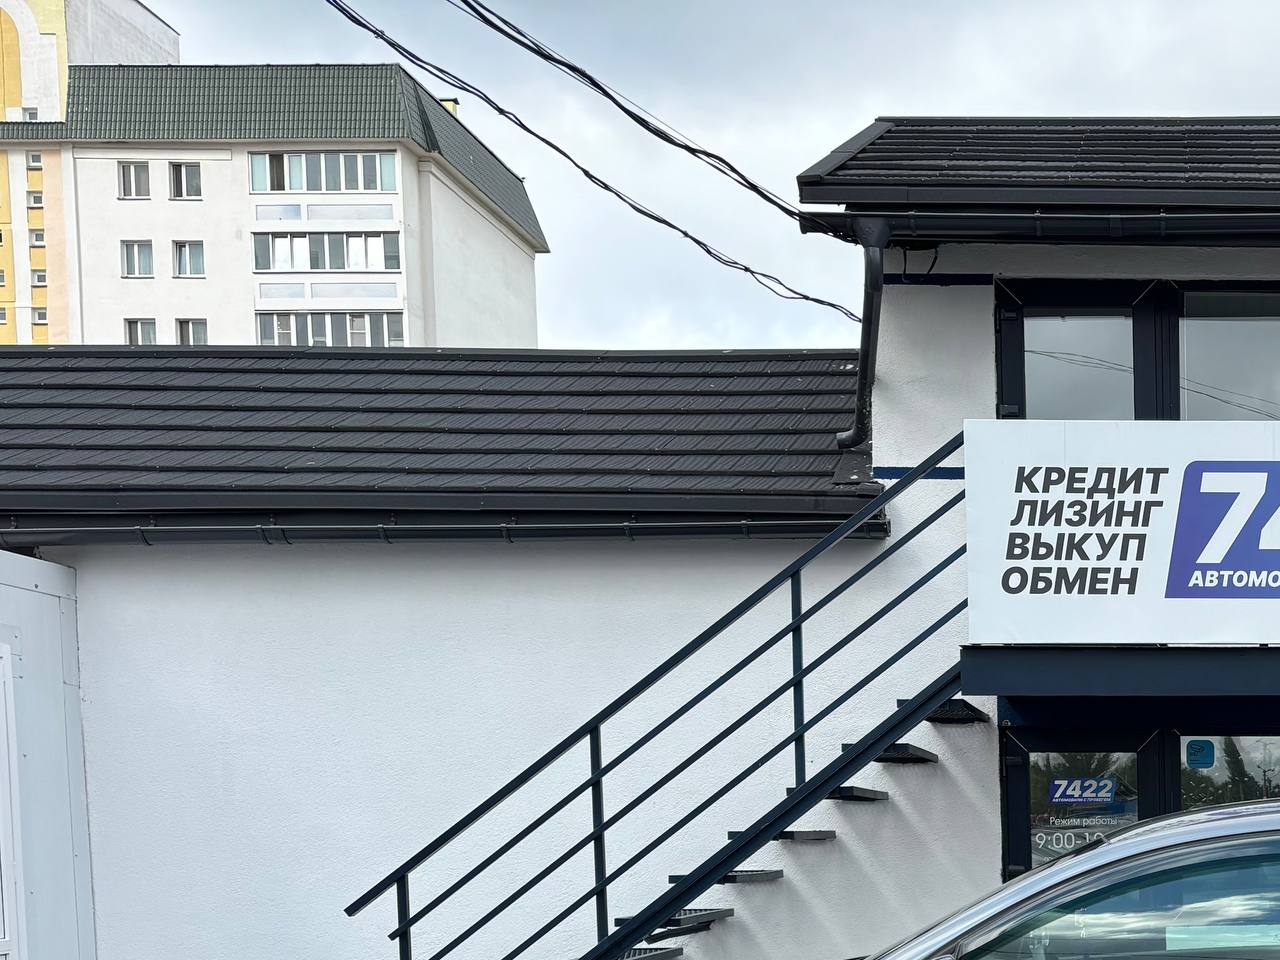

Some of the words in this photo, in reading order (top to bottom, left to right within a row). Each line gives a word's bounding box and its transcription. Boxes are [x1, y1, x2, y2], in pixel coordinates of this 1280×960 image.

[1014, 466, 1169, 499] КРЕДИТ
[1010, 499, 1164, 528] ЛИЗИНГ
[1005, 532, 1146, 561] ВЫКУП
[1001, 566, 1138, 595] ОБМЕН
[1053, 780, 1113, 798] 7422
[1049, 816, 1080, 825] Режим
[1082, 816, 1118, 827] работы
